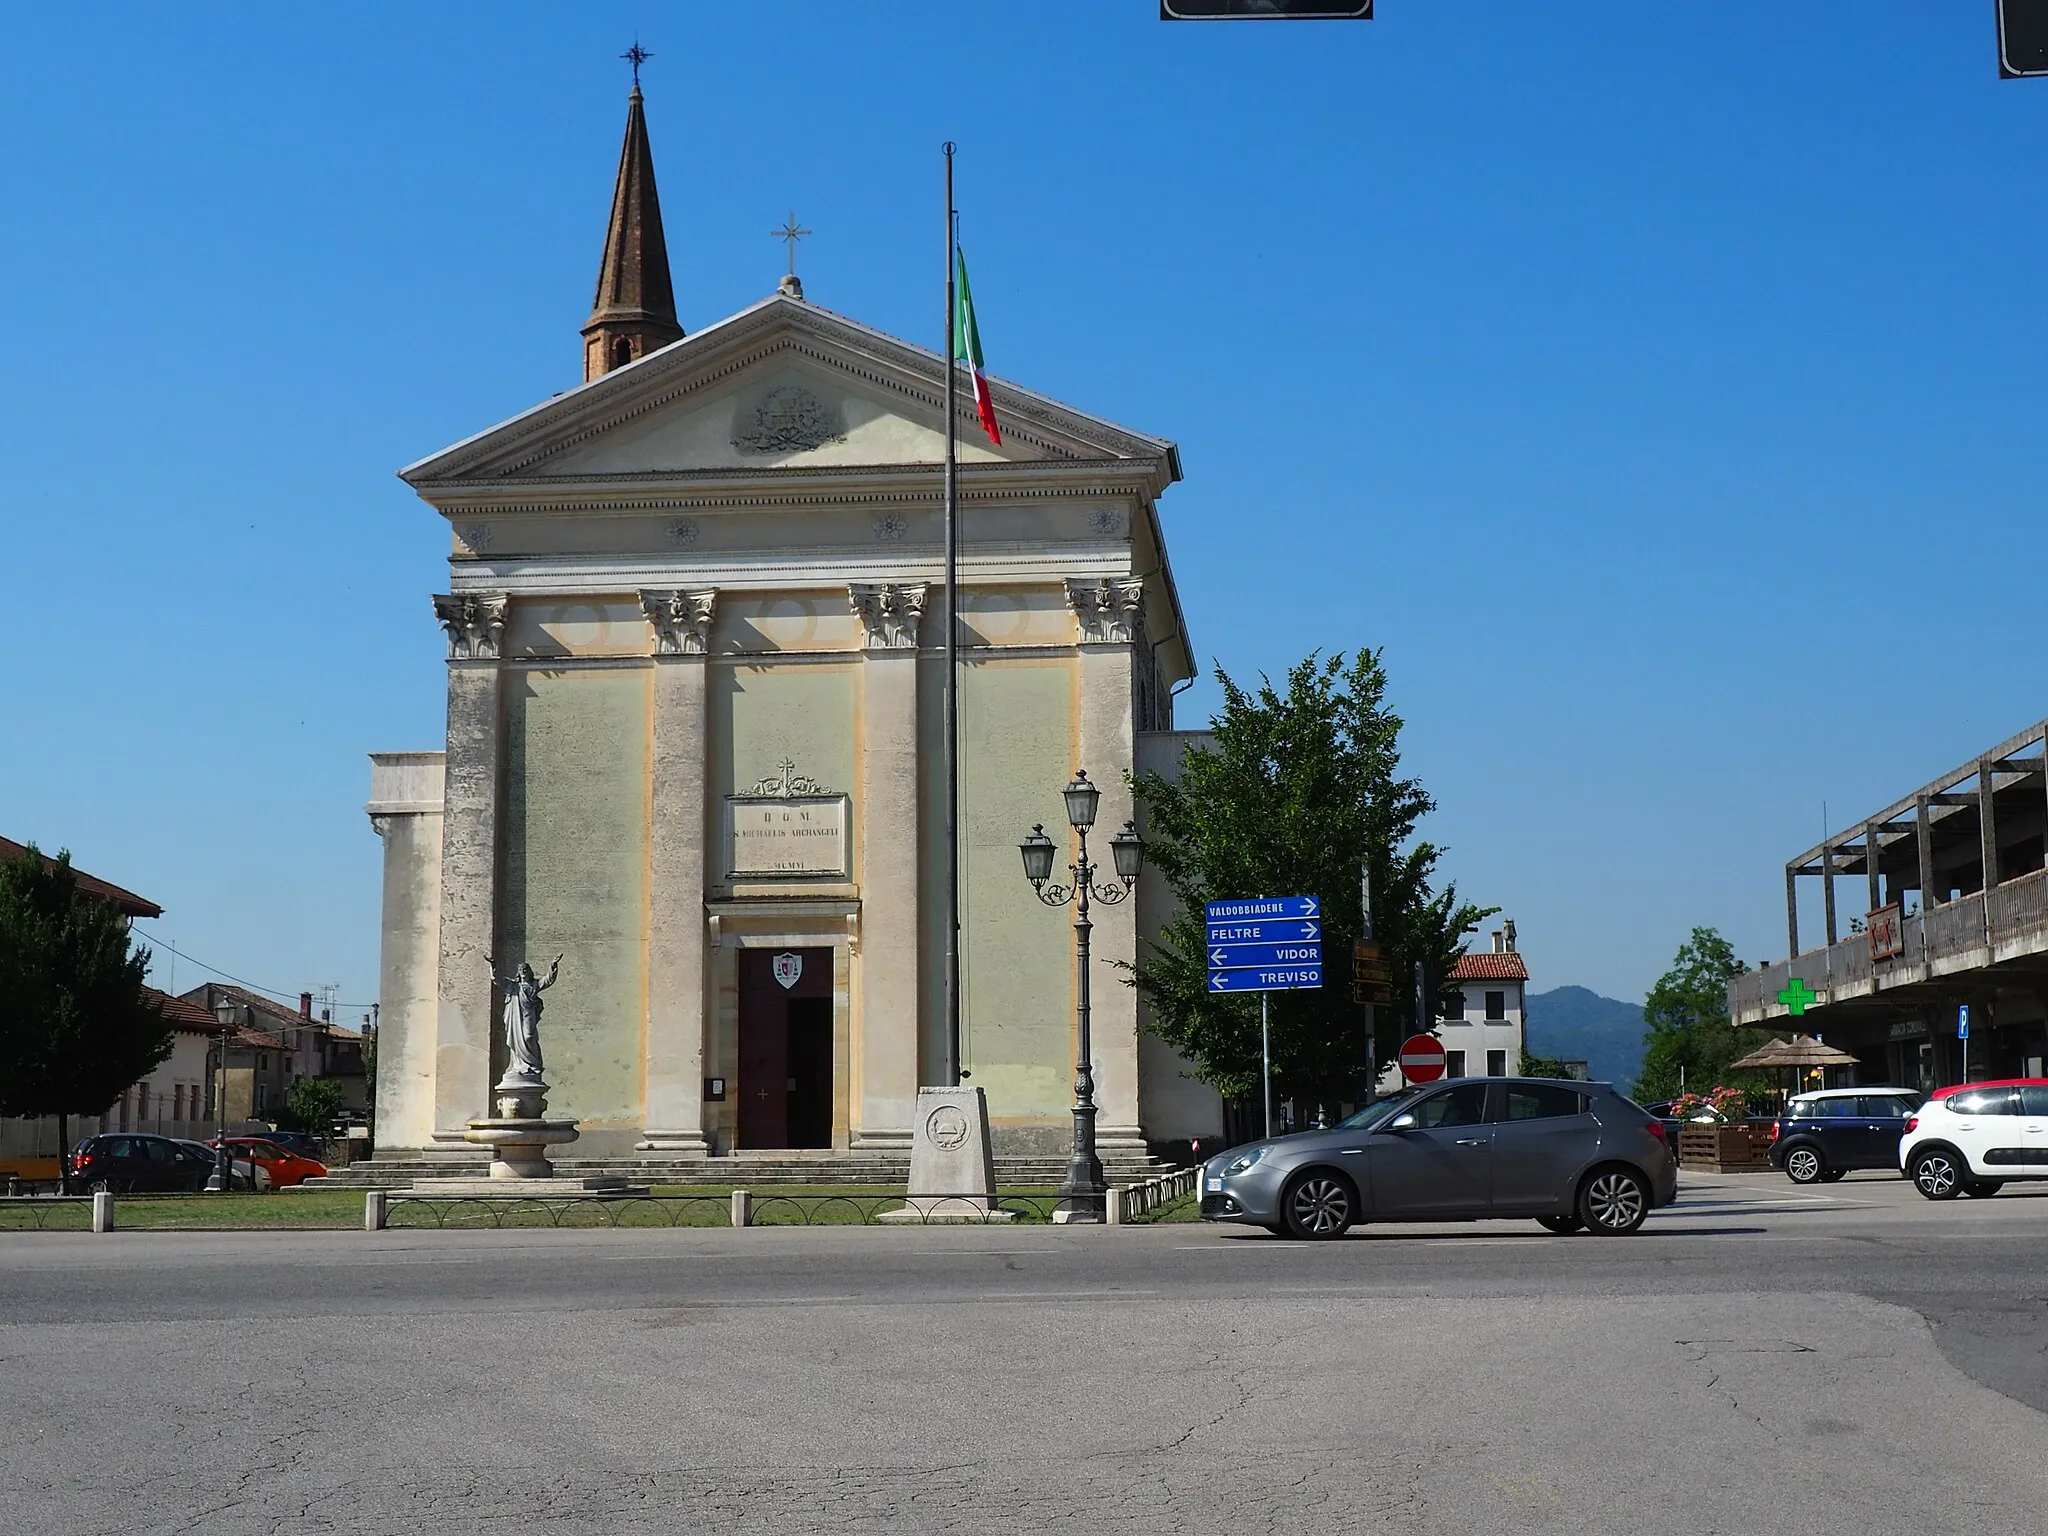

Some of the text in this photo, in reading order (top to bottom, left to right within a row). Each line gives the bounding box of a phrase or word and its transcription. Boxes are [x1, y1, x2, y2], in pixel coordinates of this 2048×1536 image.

[1209, 903, 1284, 917] VALDOBBIADENE
[1211, 927, 1261, 940] FELTRE
[1276, 948, 1318, 960] VIDOR
[1259, 970, 1319, 984] TREVISO
[1961, 1010, 1967, 1034] P
